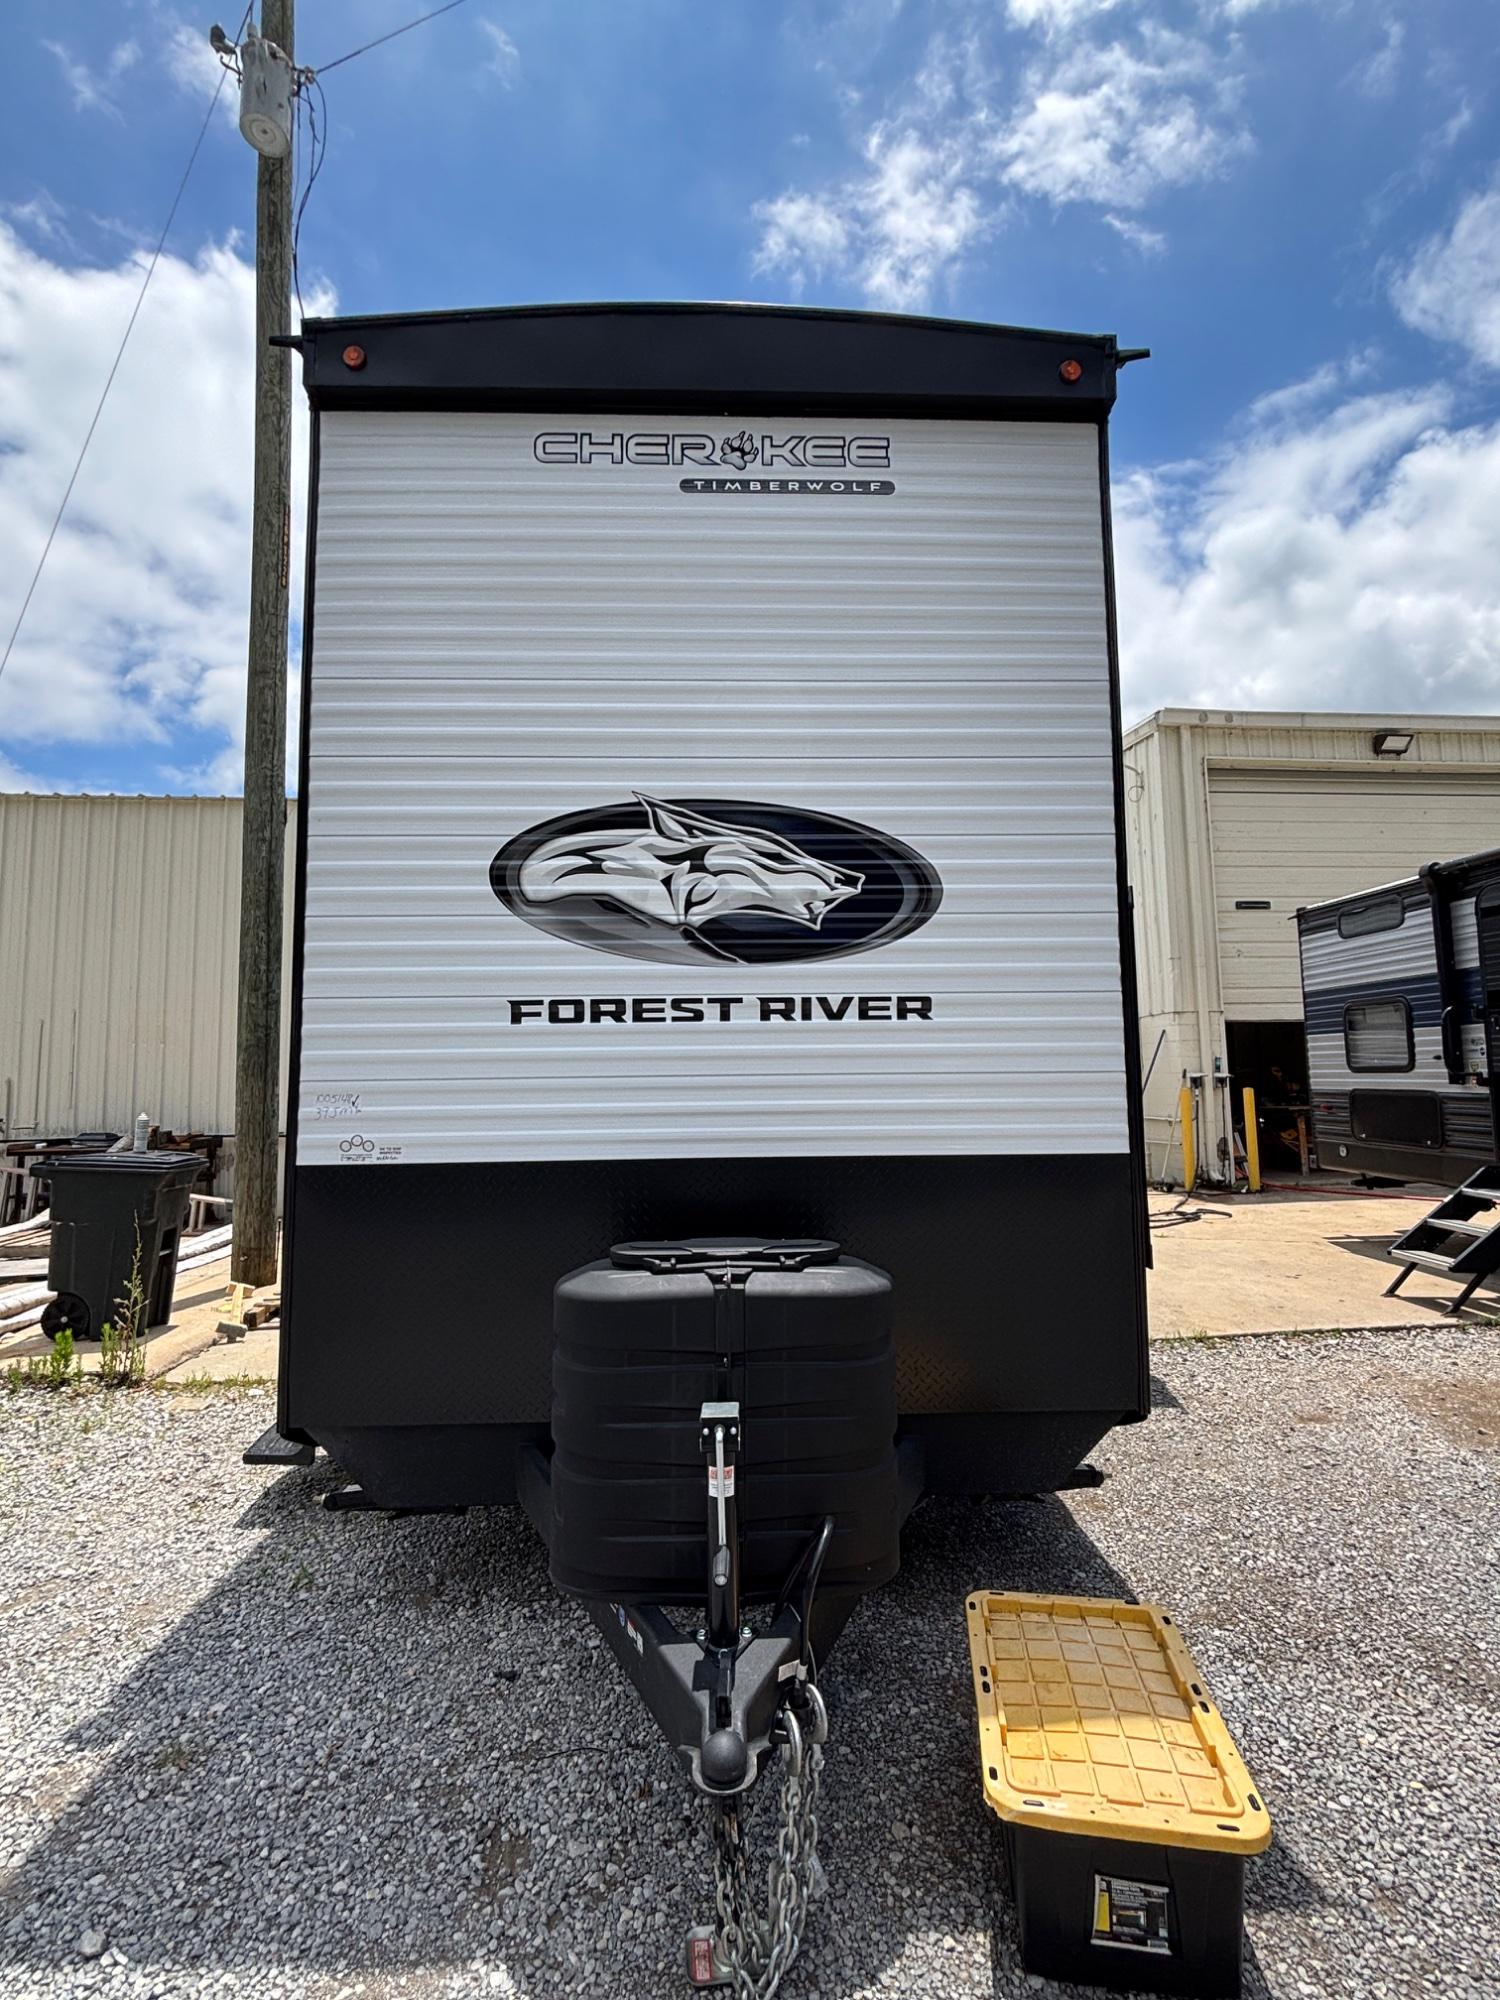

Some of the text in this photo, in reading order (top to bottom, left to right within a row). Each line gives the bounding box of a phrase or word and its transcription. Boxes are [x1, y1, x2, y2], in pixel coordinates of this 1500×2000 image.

[693, 480, 882, 493] TIMBERWOLF
[507, 996, 933, 1025] FOREST RIVER
